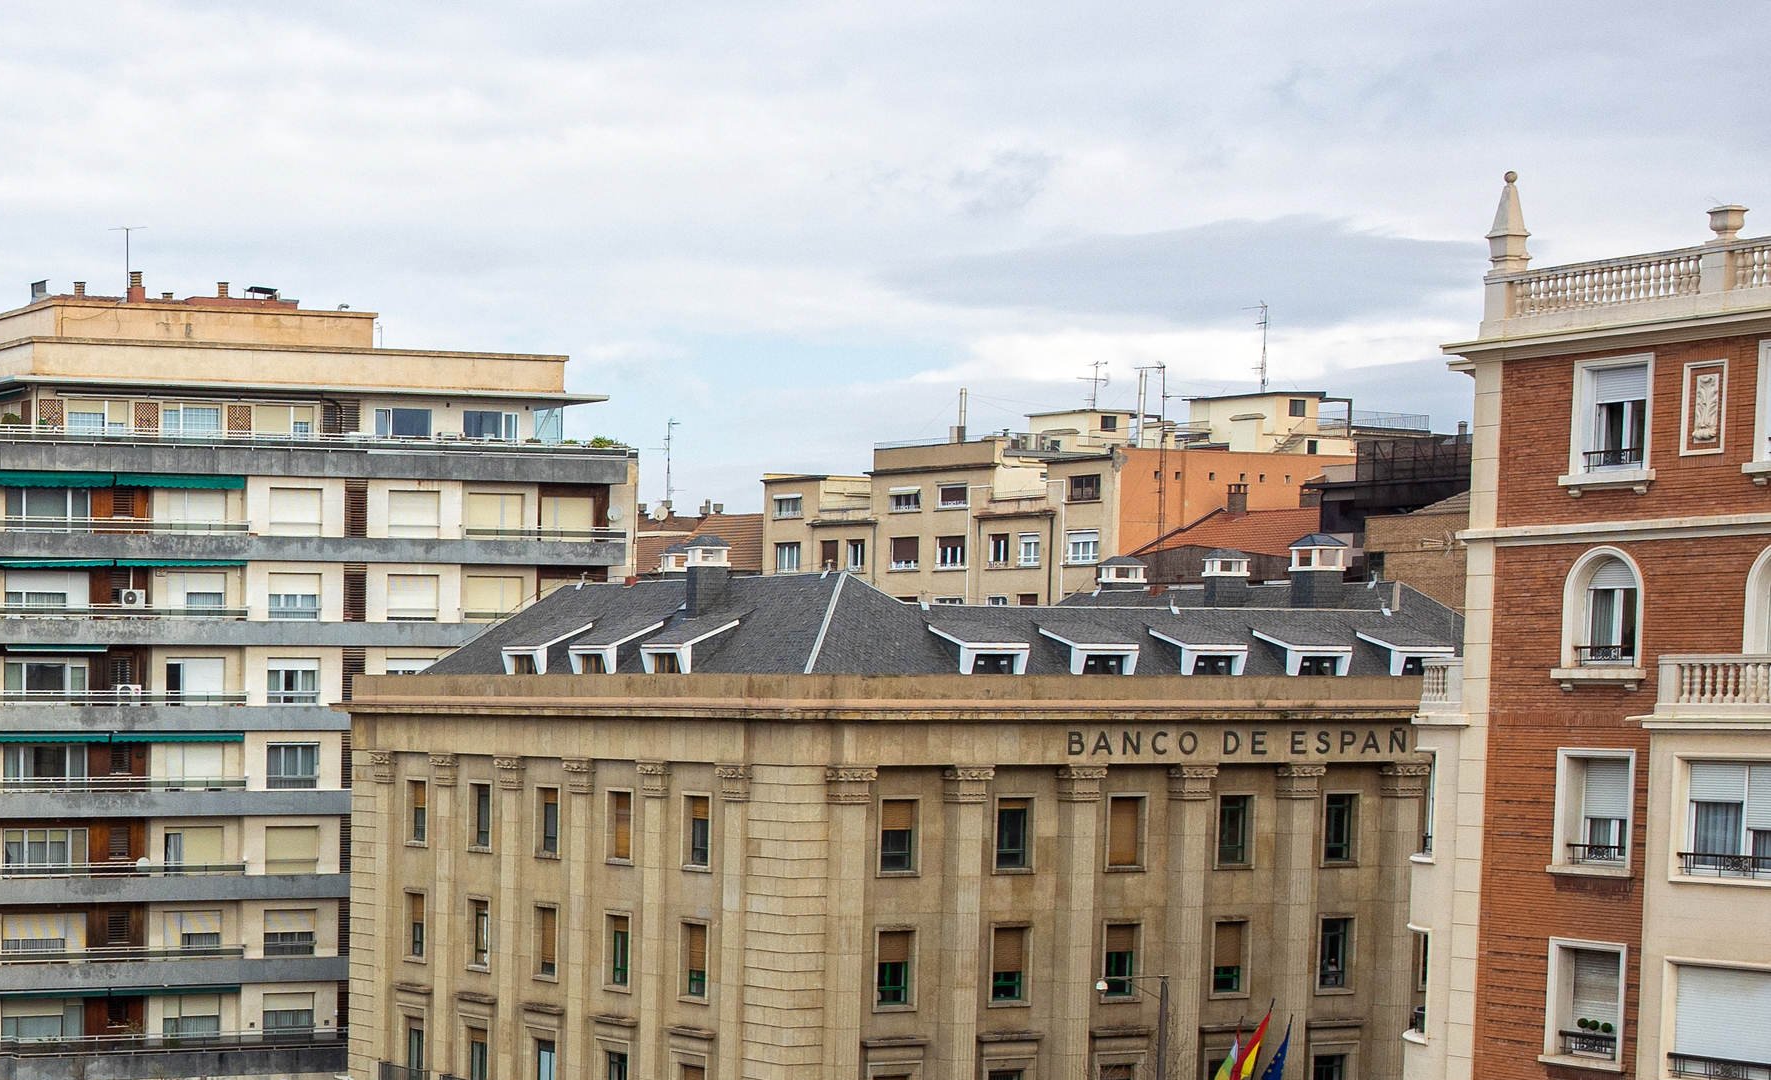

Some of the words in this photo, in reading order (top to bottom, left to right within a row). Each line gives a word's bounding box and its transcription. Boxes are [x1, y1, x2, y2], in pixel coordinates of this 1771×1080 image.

[1067, 731, 1199, 755] BANCO
[1223, 731, 1268, 755] DE
[1290, 727, 1408, 755] ESPAÑ
